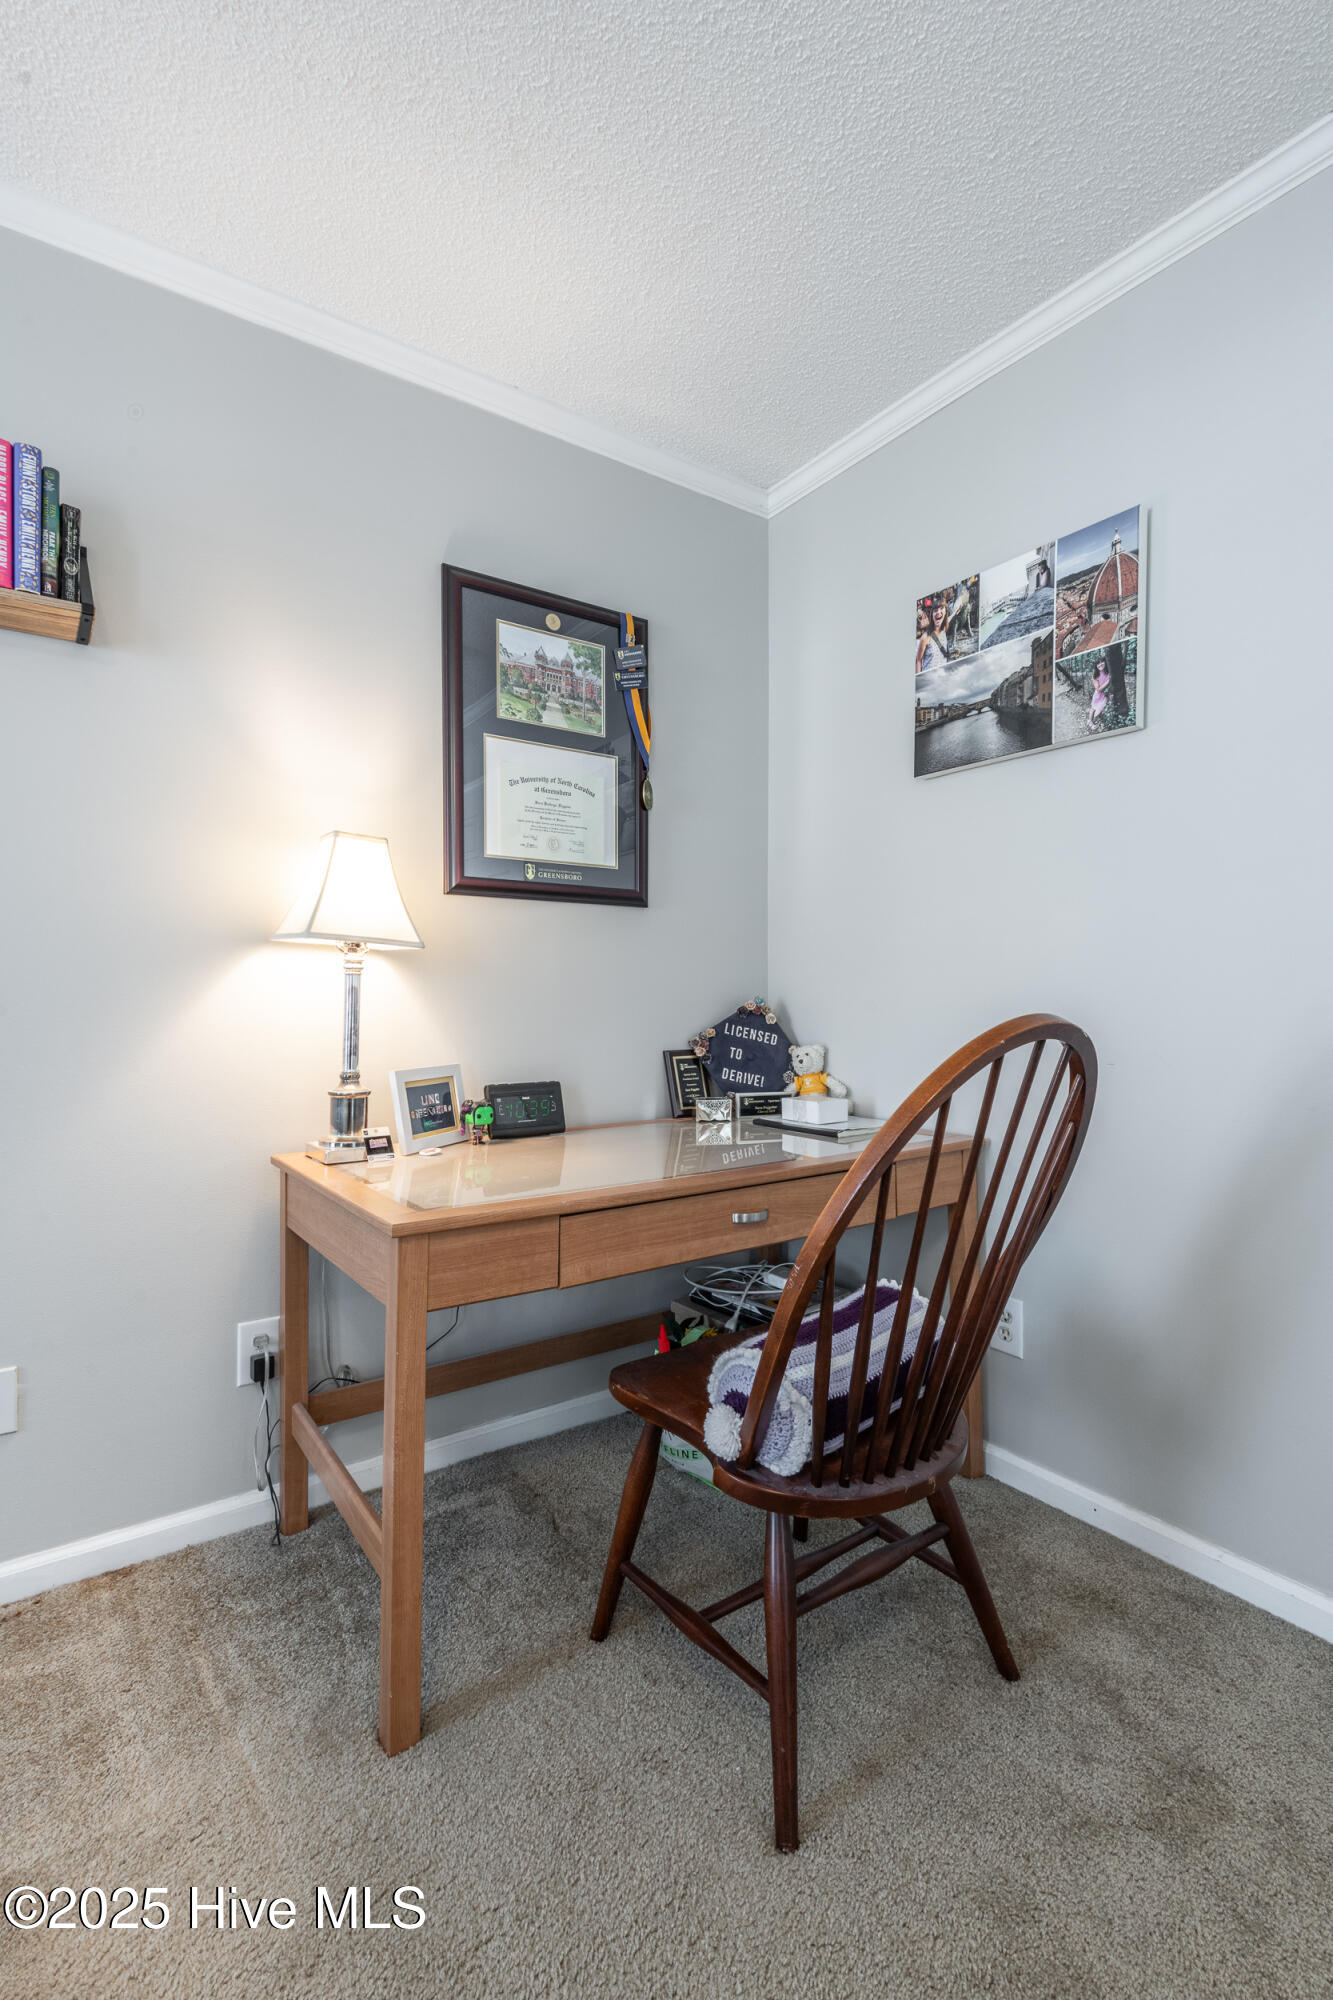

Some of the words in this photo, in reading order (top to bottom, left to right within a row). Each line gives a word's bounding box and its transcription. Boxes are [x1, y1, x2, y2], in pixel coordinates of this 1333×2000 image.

[23, 453, 37, 482] FUNNY
[22, 483, 37, 512] STORY
[22, 519, 36, 547] EMILY
[21, 547, 36, 575] HENRY
[508, 779, 519, 787] The
[557, 777, 573, 786] North
[573, 783, 595, 798] Carolina
[540, 787, 572, 797] Greensboro
[538, 871, 583, 881] GREENSBORO
[724, 1022, 778, 1046] LICENSED
[729, 1046, 743, 1060] TO
[721, 1067, 765, 1088] DERIVE!
[420, 1093, 440, 1106] UNC
